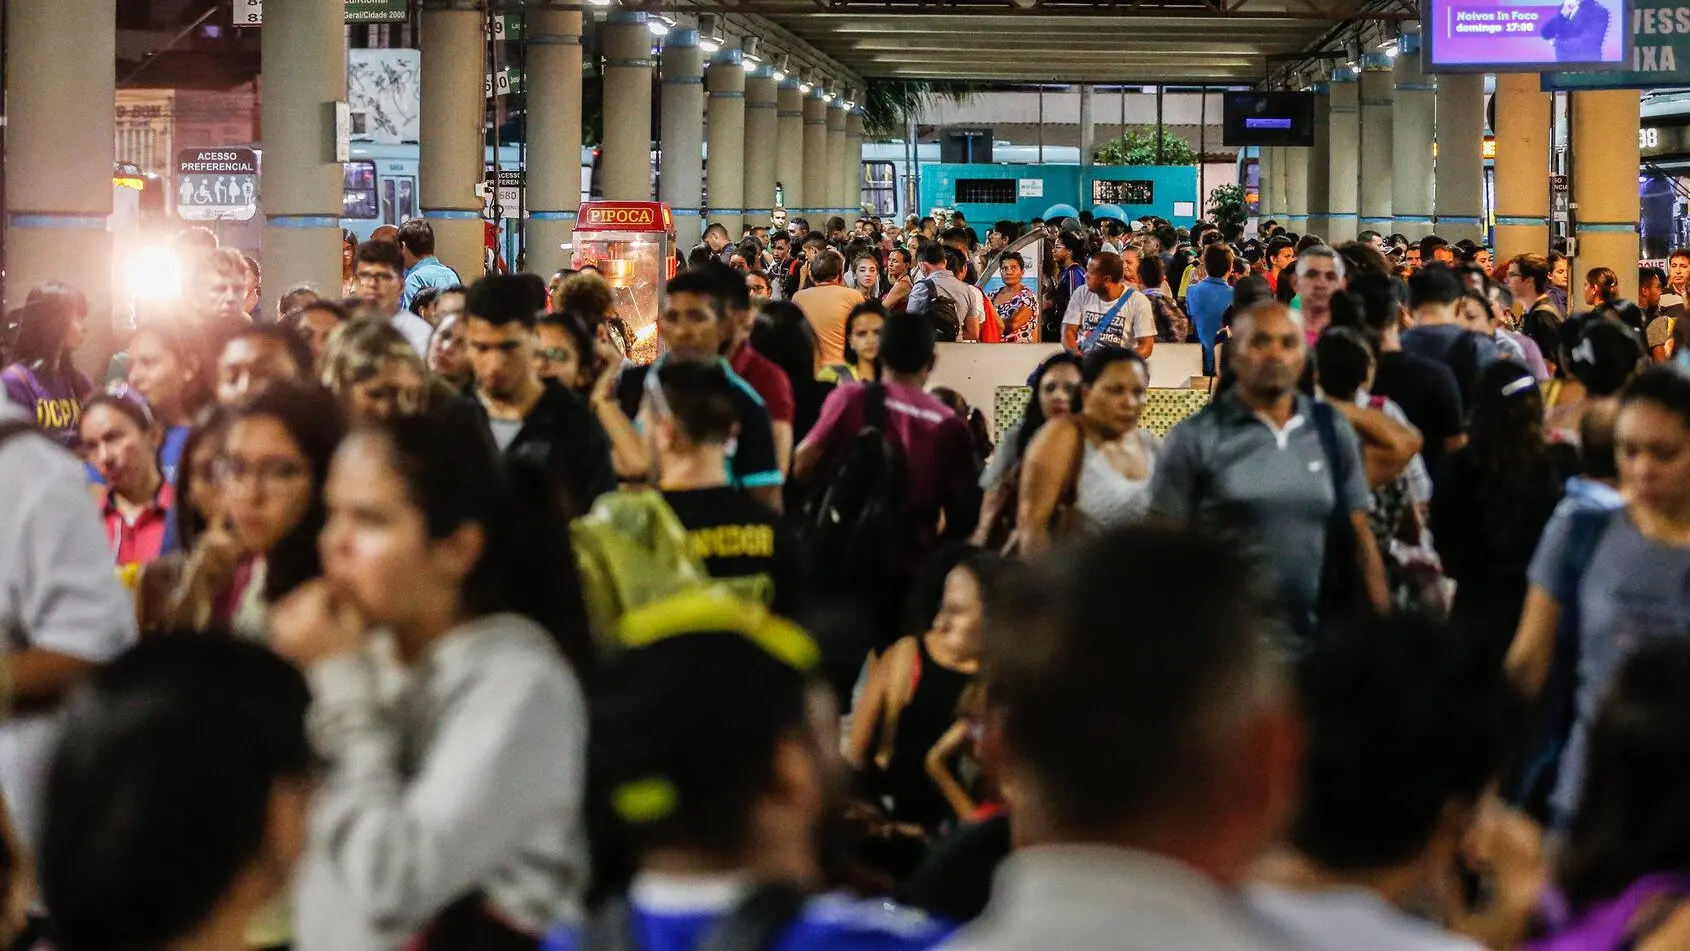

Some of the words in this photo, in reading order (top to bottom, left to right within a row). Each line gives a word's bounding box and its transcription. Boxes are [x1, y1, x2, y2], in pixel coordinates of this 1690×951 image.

[389, 11, 406, 19] 2000
[1456, 11, 1495, 21] Noivos
[1455, 22, 1502, 34] domingo
[197, 152, 237, 161] ACESSO
[181, 162, 254, 171] PREFERENCIAL
[590, 209, 651, 223] PIPOCA
